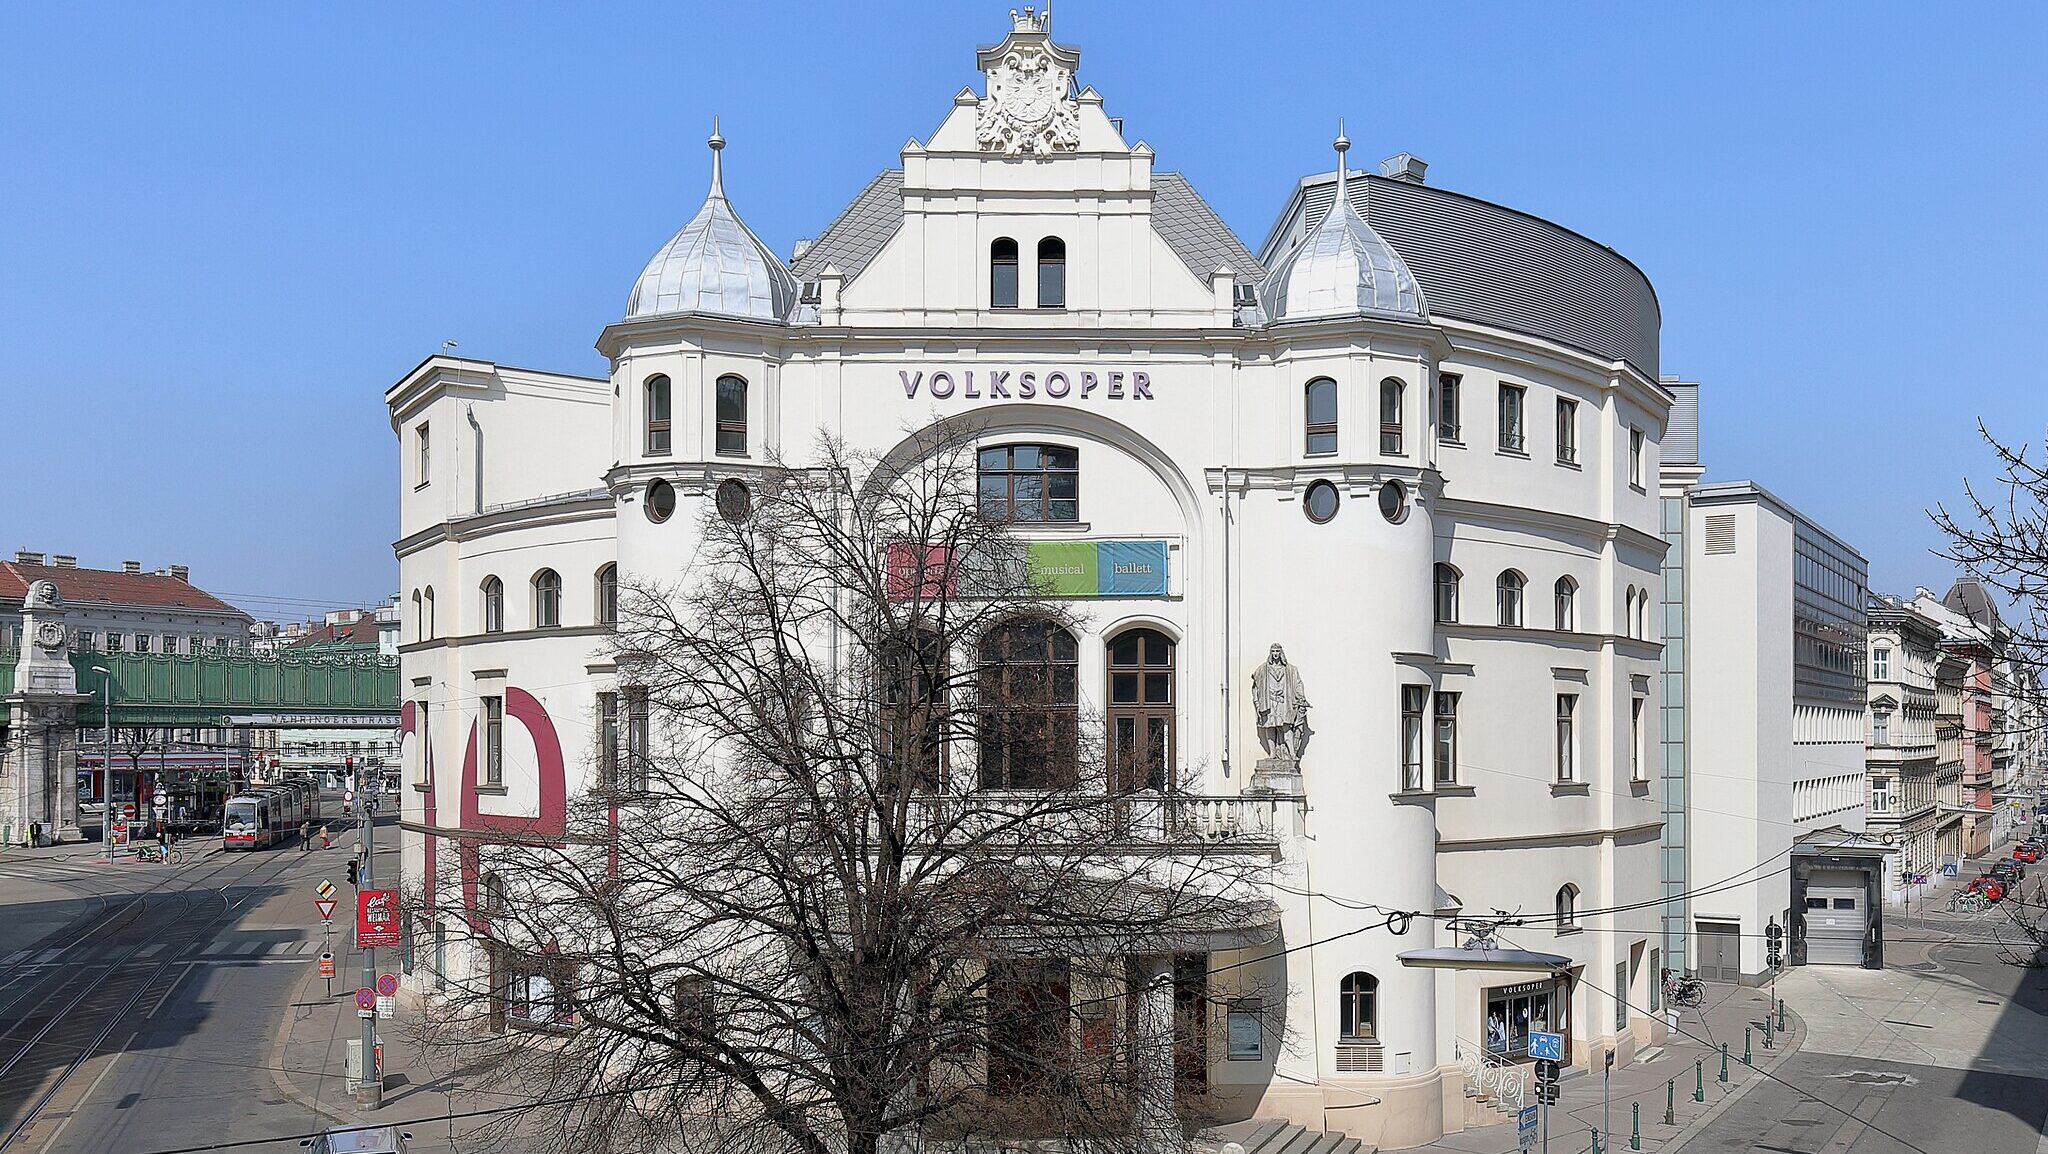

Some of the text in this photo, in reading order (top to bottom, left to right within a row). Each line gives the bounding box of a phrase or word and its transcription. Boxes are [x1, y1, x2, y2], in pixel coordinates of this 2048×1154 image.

[898, 370, 1154, 400] VOLKSOPER
[1040, 563, 1085, 575] musical
[1114, 562, 1153, 574] ballett
[1502, 982, 1543, 994] VOLKSOPER
